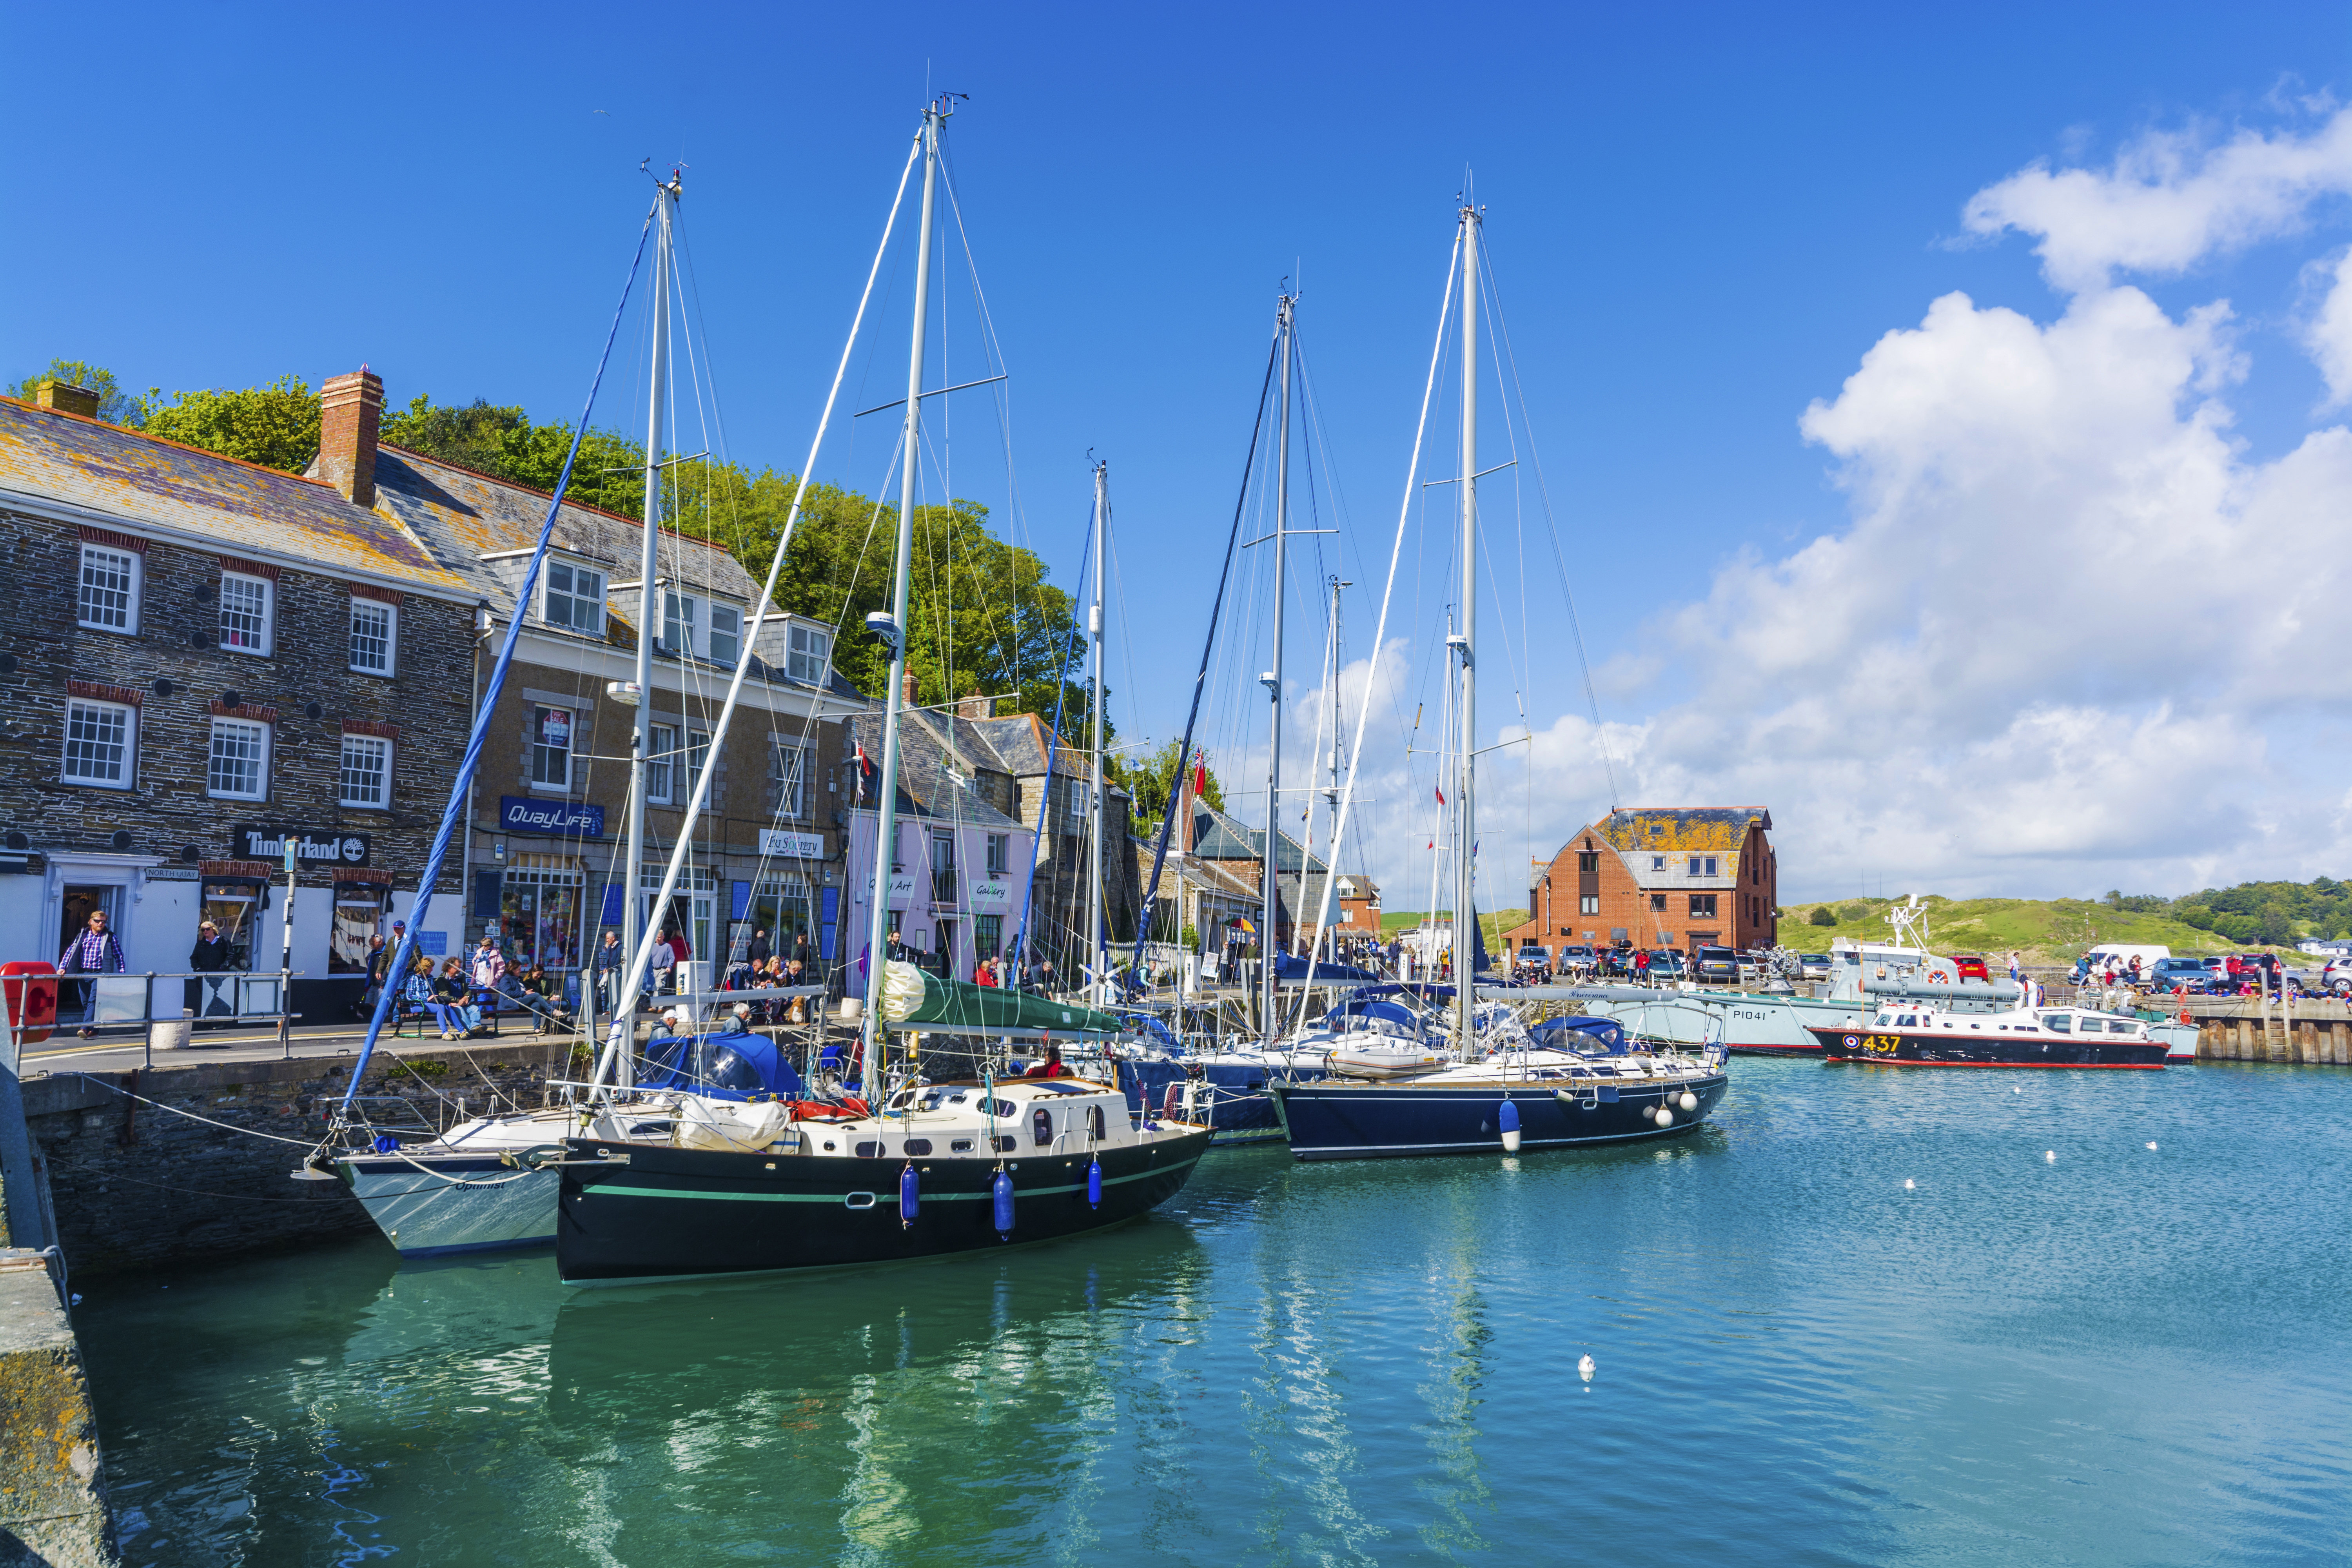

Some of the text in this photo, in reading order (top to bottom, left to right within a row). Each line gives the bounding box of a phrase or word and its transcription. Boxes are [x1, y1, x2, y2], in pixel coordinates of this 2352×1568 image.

[245, 831, 339, 860] Timbrland
[895, 880, 912, 891] Art
[1863, 1035, 1900, 1052] 437
[456, 1182, 506, 1192] Optimist
